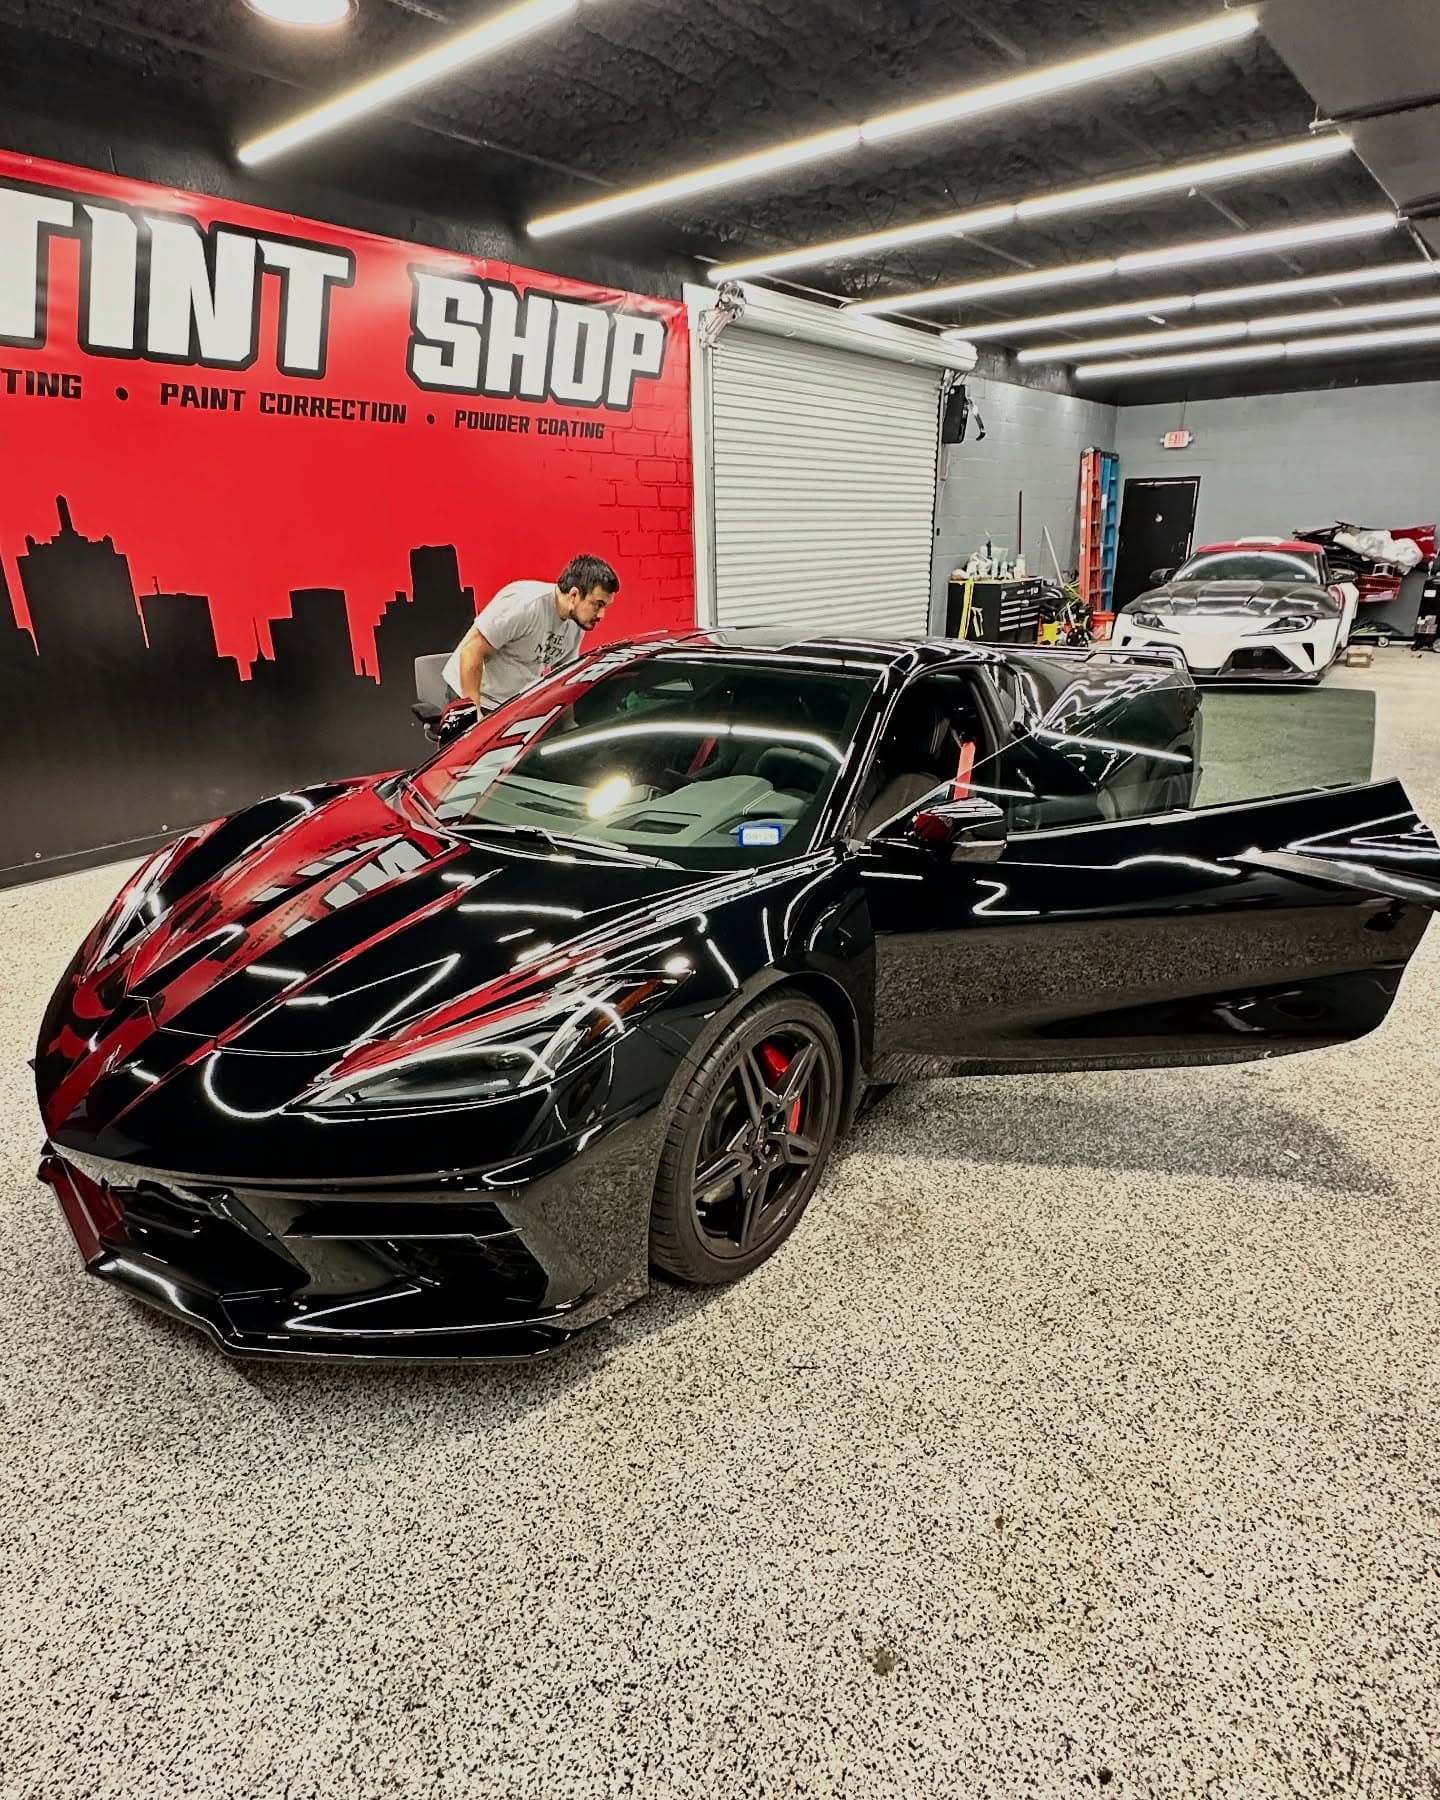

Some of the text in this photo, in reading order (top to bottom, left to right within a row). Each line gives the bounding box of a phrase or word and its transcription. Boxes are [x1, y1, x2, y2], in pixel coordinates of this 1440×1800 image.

[0, 187, 666, 406] TINT SHOP
[0, 368, 605, 439] TING PAINT CORRECTION POWDER COATING
